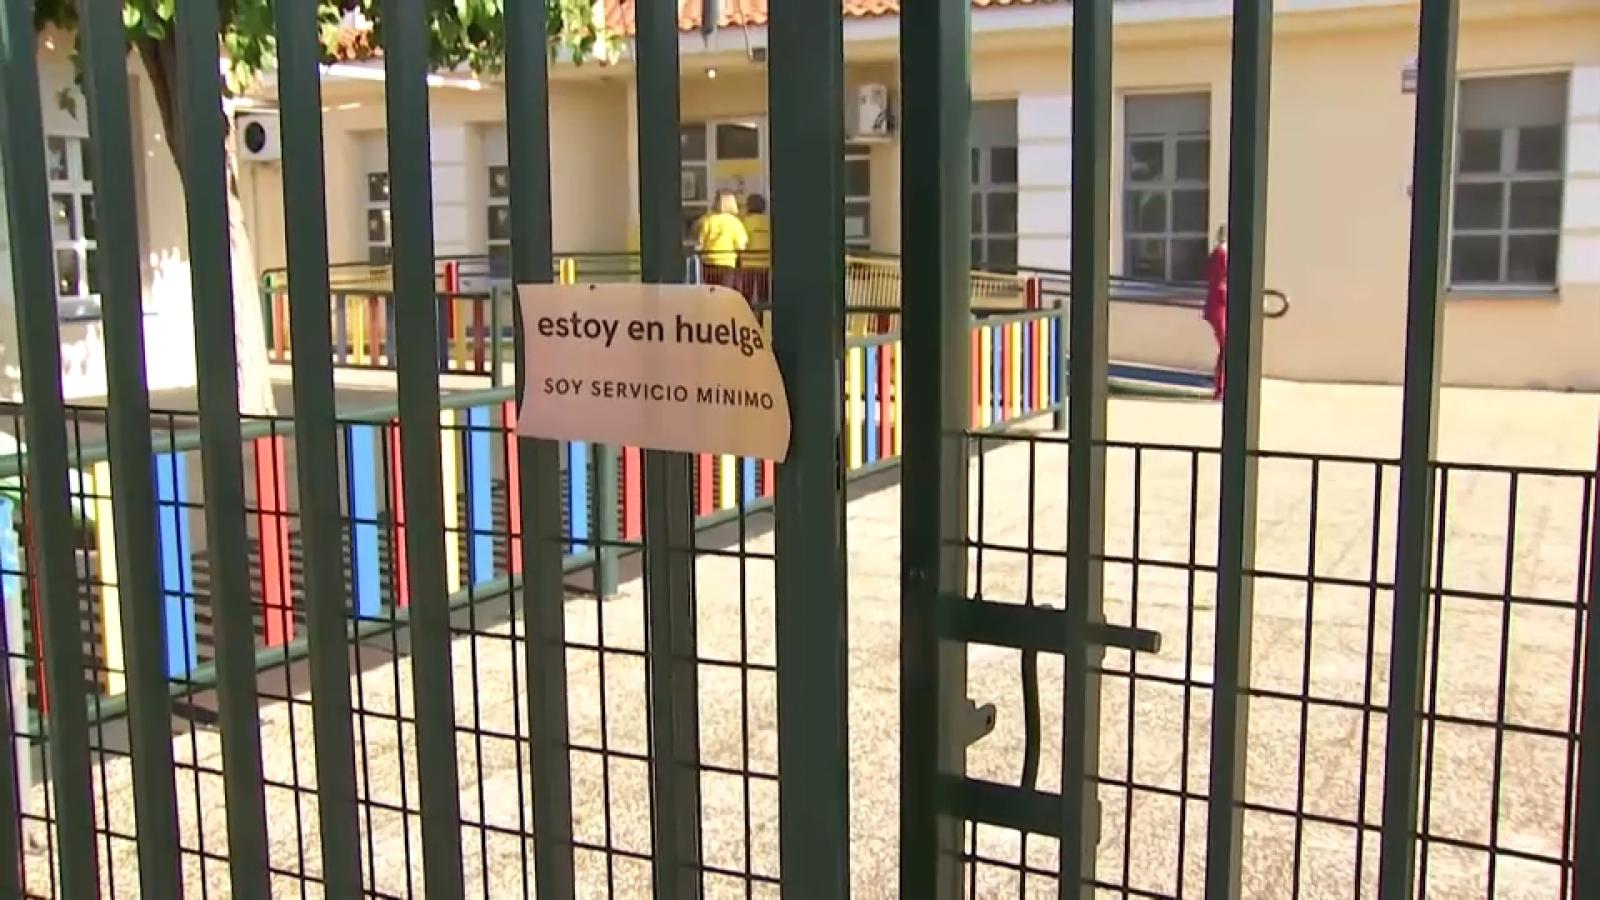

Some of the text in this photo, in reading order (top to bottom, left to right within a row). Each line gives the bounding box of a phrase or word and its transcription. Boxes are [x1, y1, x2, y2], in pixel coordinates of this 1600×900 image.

[538, 311, 764, 357] estoy en huelga
[544, 378, 774, 410] SOY SERVICIO MÍNIMO
